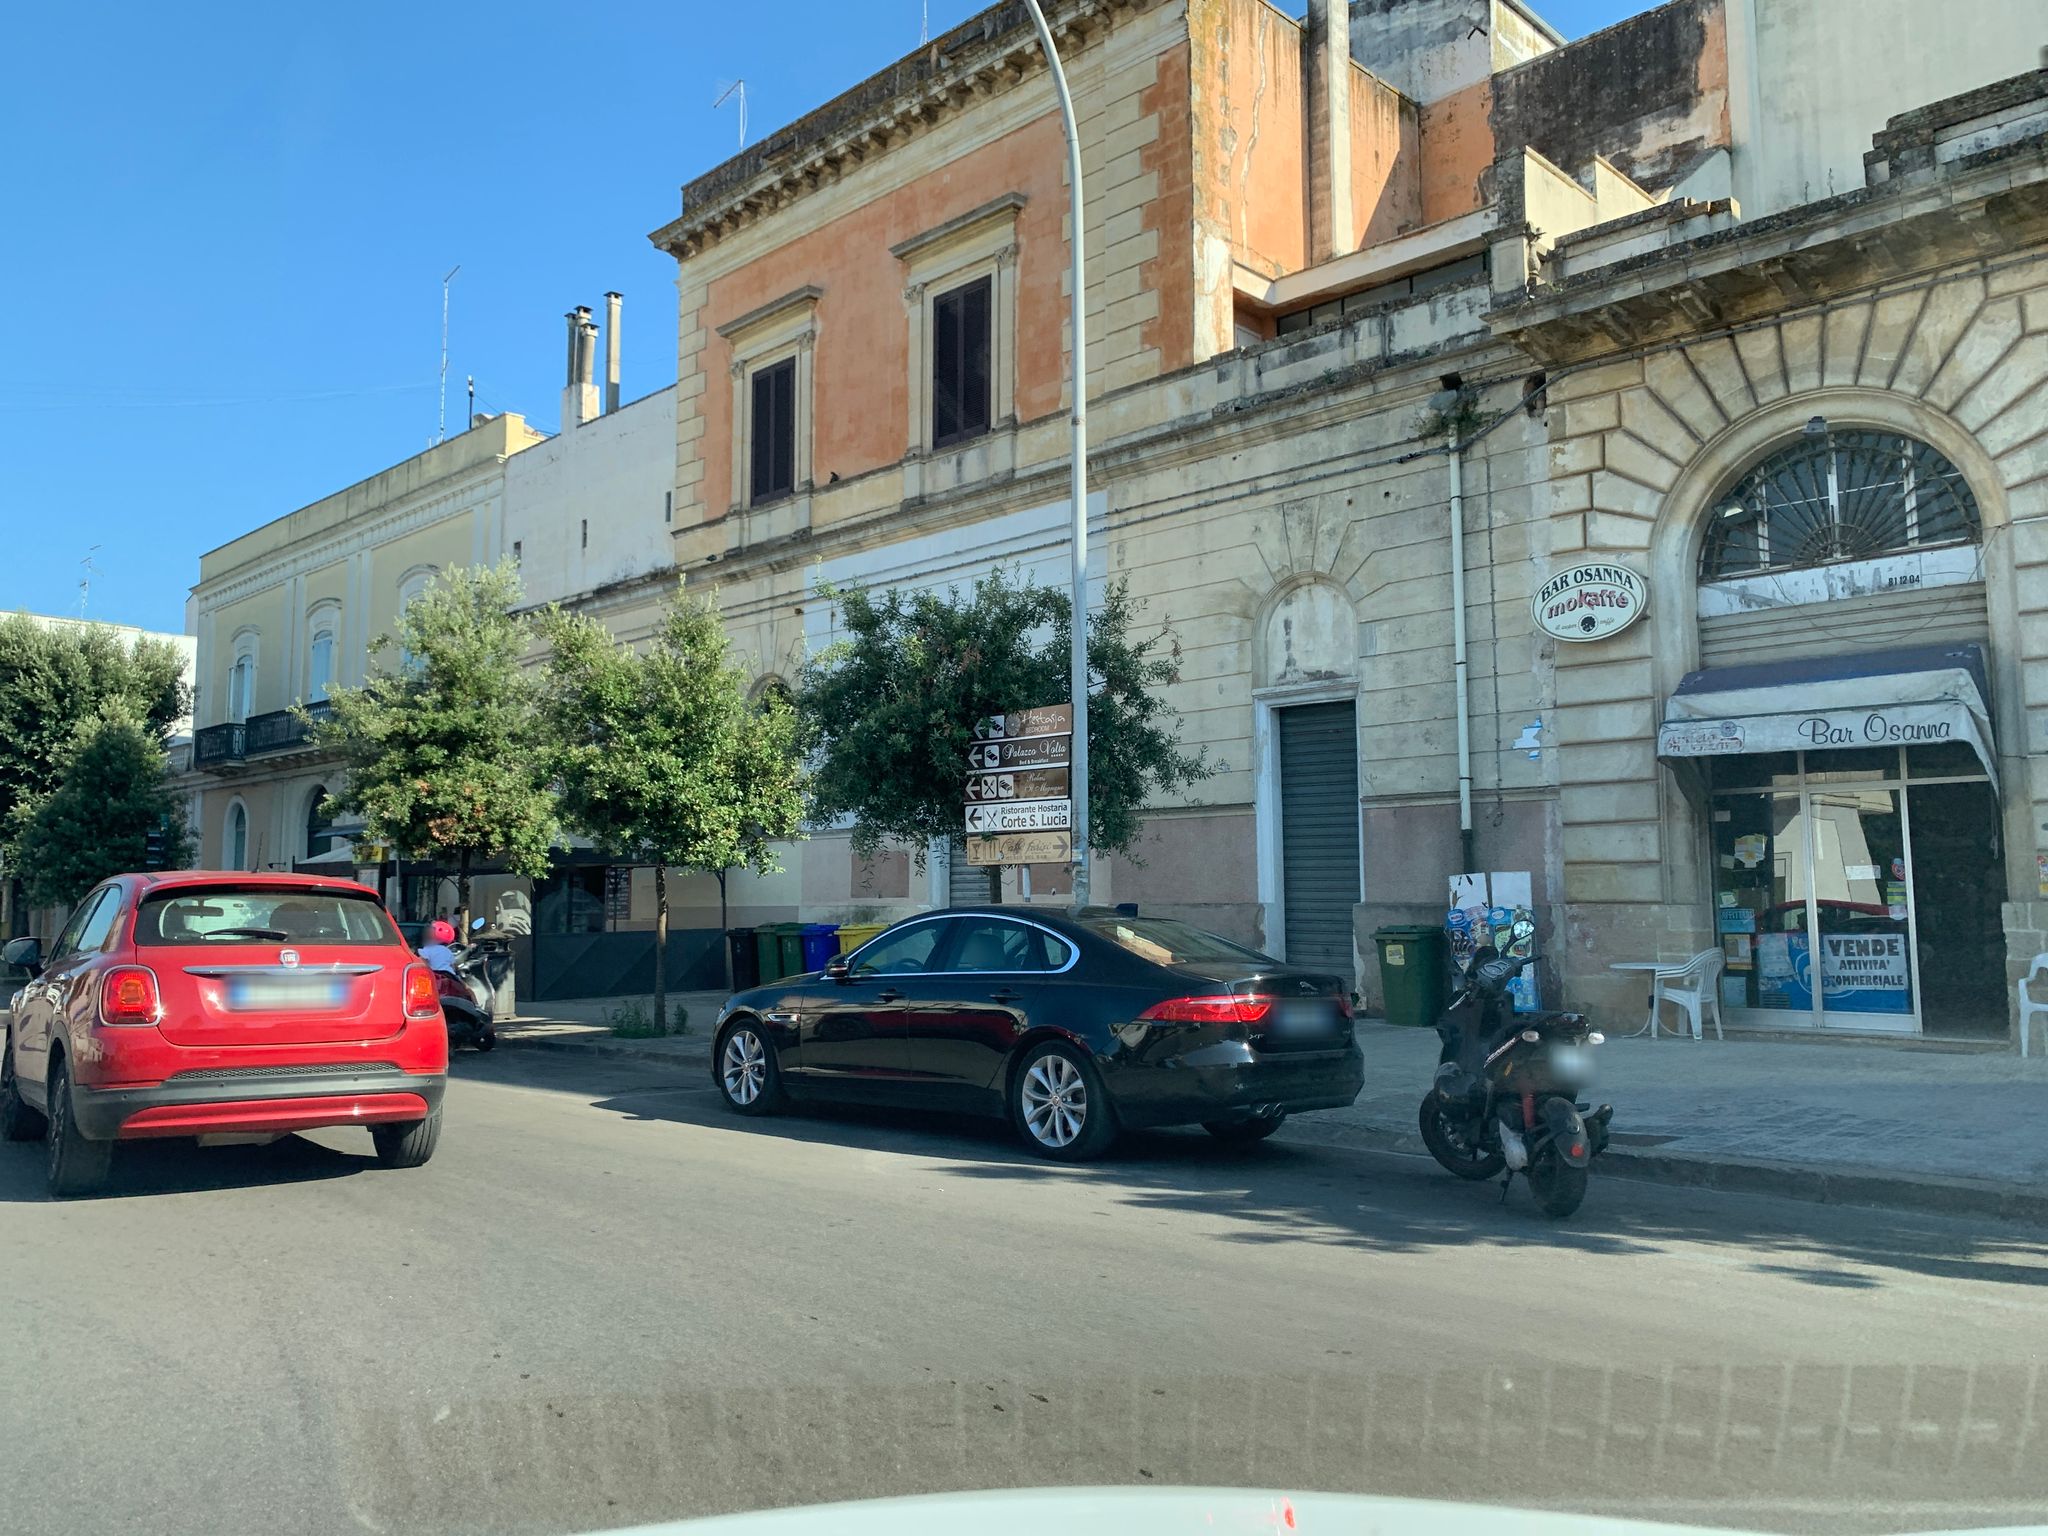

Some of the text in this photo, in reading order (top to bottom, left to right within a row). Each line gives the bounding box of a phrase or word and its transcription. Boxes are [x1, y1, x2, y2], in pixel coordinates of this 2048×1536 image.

[1541, 567, 1635, 603] BAR OSANNA
[1797, 713, 1951, 745] Bar Osanna
[1002, 744, 1036, 759] Palazzo
[1000, 802, 1068, 815] Ristorante Hostaria
[1001, 812, 1068, 828] Corte S. Lucia
[1828, 939, 1900, 957] VENDE
